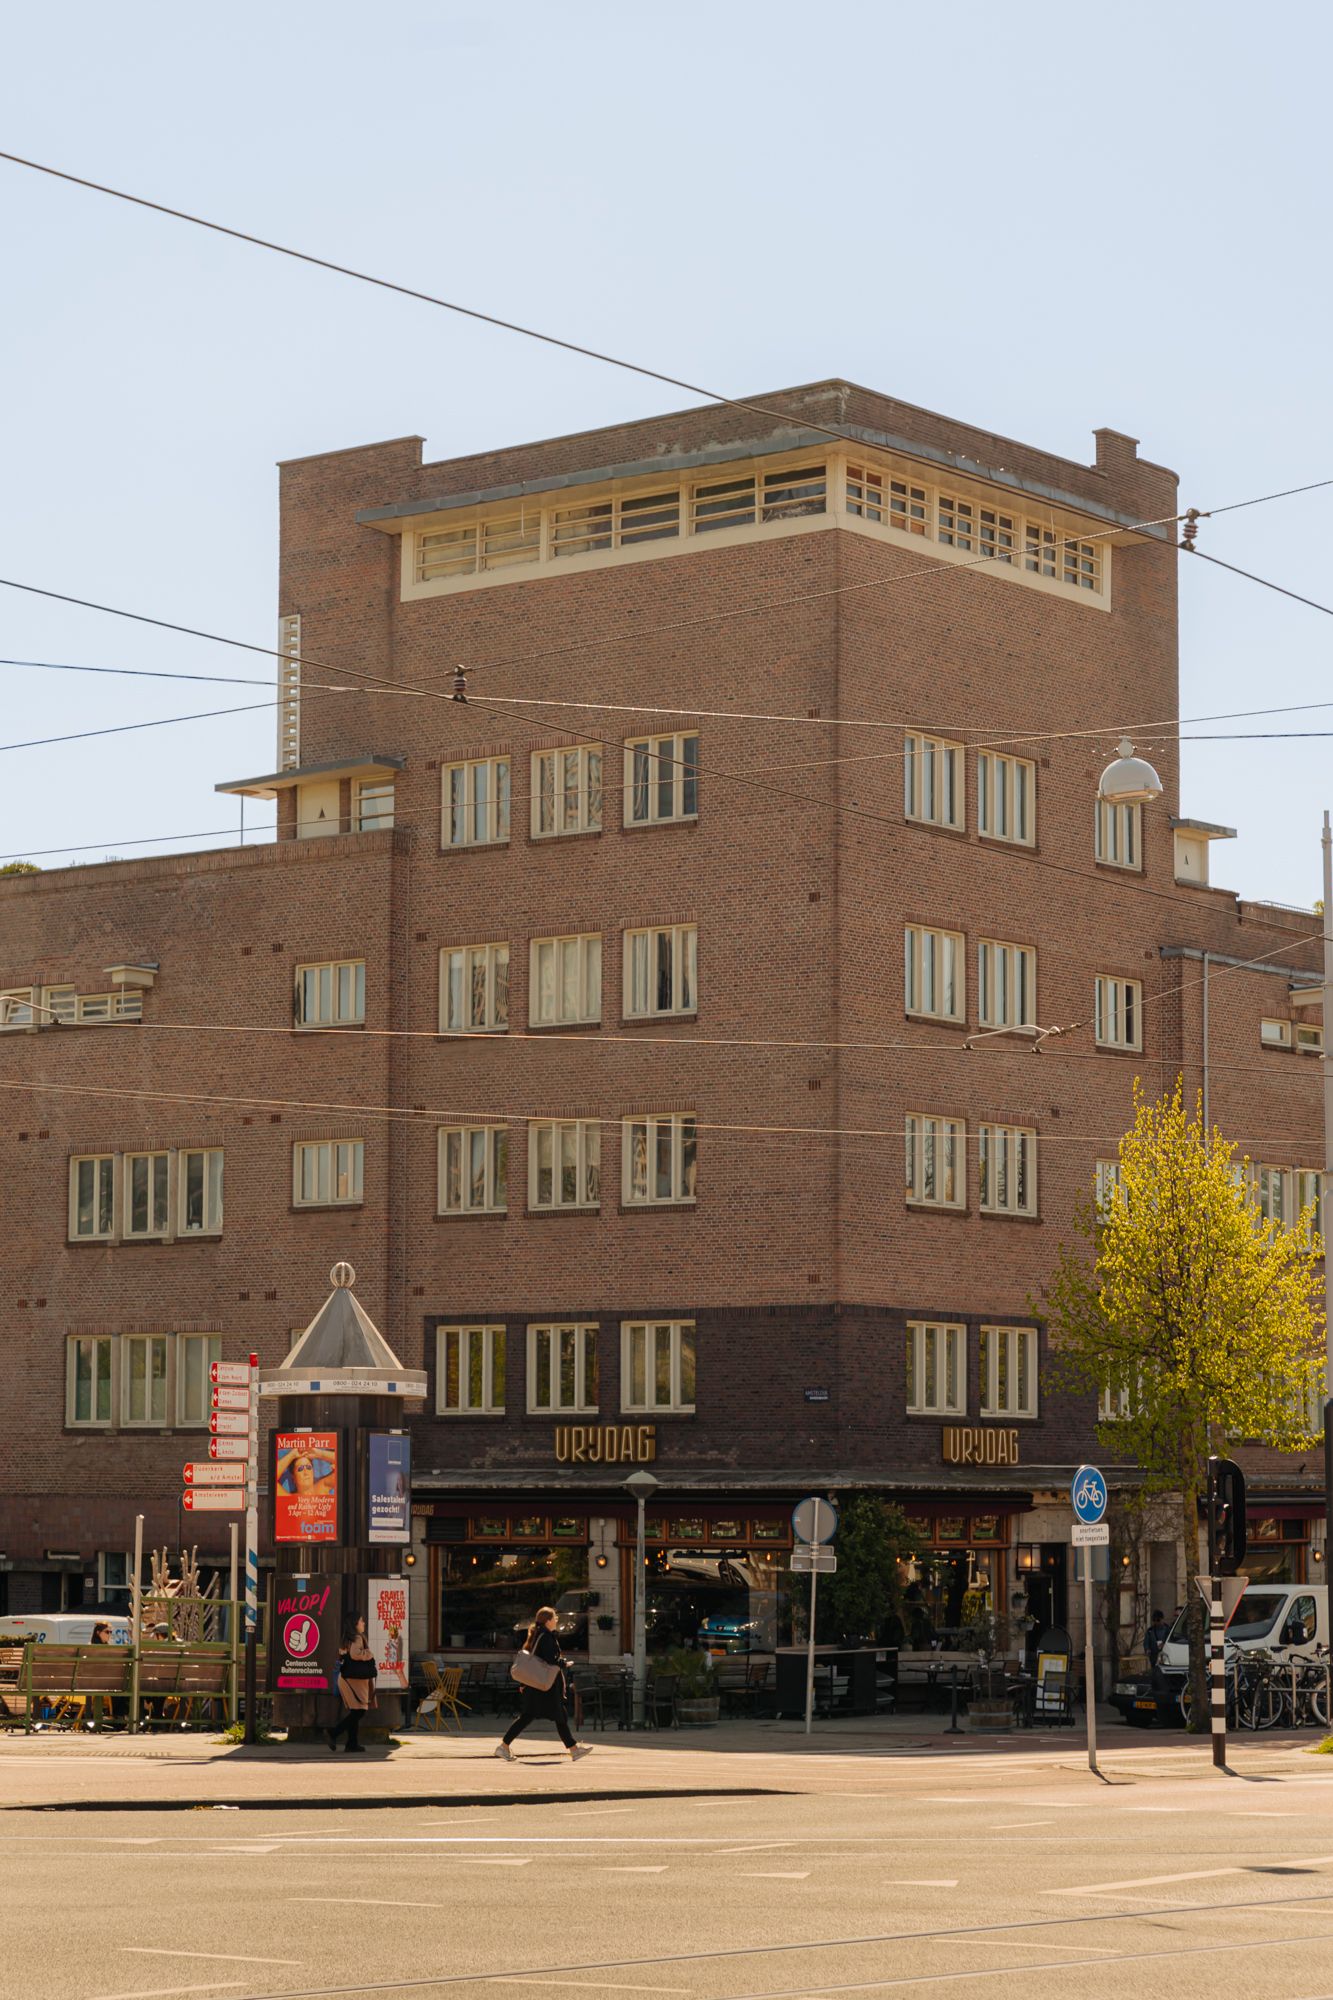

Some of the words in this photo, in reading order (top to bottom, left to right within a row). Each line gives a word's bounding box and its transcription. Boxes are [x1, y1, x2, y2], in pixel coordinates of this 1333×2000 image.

[277, 1437, 306, 1449] Martin
[308, 1436, 330, 1448] Parr
[556, 1426, 653, 1462] VRIJDAG
[948, 1427, 1019, 1464] VRIJDAG
[297, 1496, 309, 1504] Very
[318, 1503, 332, 1512] Ugly
[371, 1505, 400, 1515] gezocht!
[300, 1520, 335, 1535] foam
[377, 1600, 390, 1611] GET
[284, 1659, 318, 1668] Centercom
[280, 1666, 323, 1675] Buitenreclame
